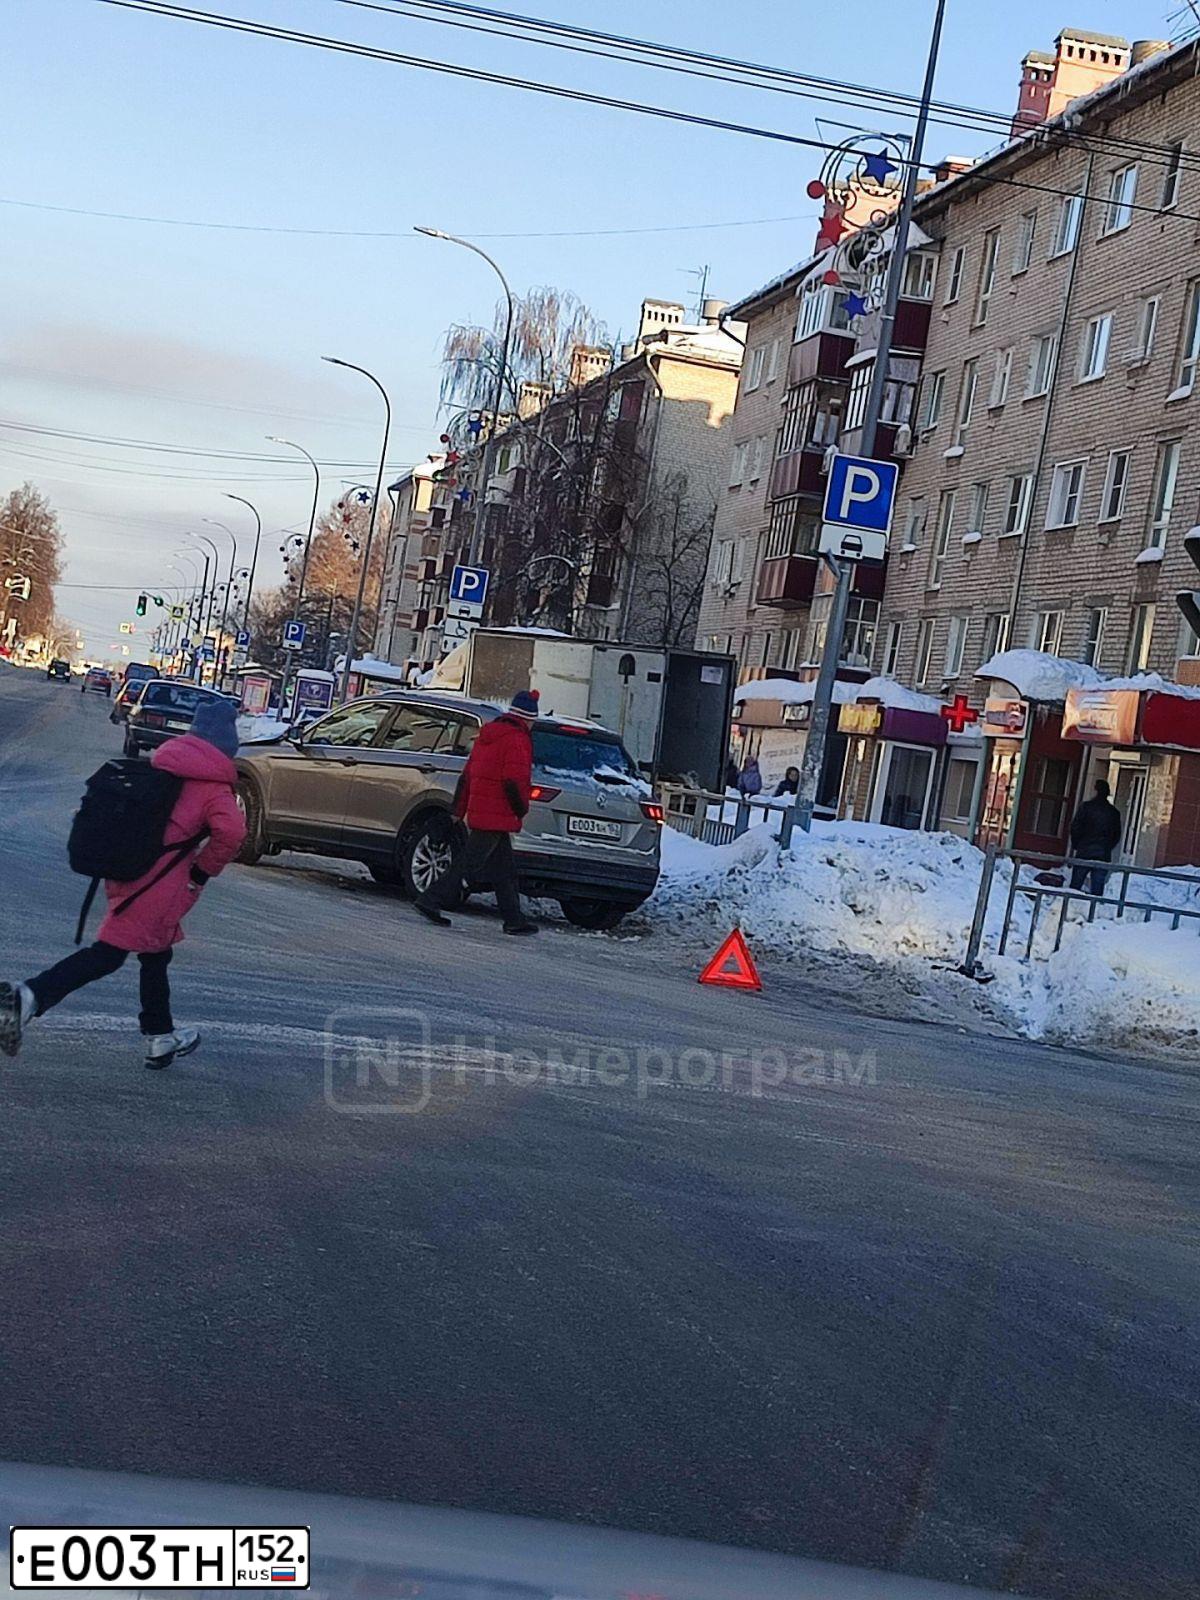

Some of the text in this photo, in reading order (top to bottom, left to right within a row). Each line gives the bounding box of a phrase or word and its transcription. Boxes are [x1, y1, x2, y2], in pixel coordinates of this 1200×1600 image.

[838, 465, 881, 519] P
[458, 570, 480, 598] P
[237, 632, 248, 644] P
[287, 623, 300, 639] P
